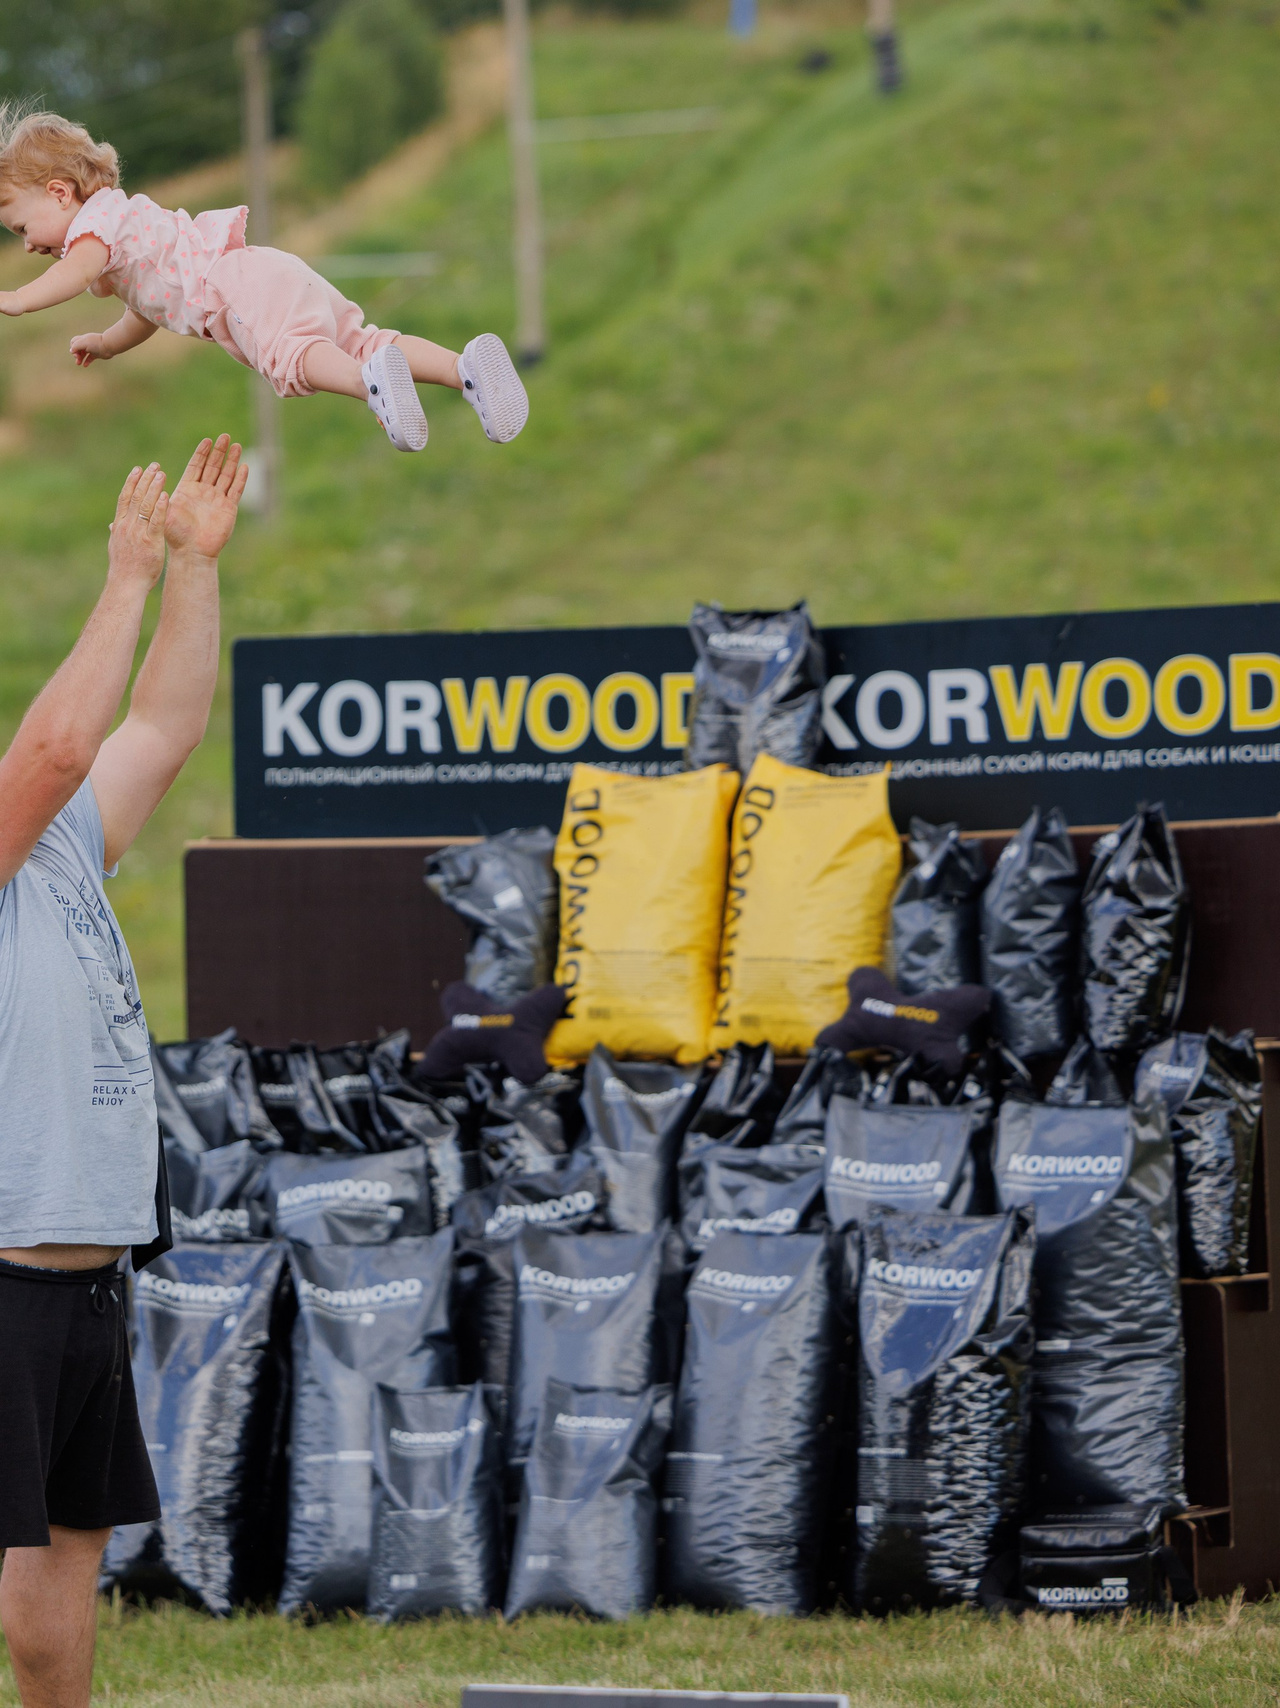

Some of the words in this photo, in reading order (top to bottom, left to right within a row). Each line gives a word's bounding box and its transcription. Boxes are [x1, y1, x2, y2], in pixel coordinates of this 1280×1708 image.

[983, 751, 1045, 775] СУХОЙ
[1046, 751, 1102, 772] КОРМ
[1102, 749, 1143, 772] ДЛЯ
[1144, 747, 1210, 768] СОБАК
[1211, 746, 1227, 765] И
[494, 763, 543, 783] КОРМ
[544, 762, 576, 784] ДЛ
[91, 1096, 124, 1106] ENJOY
[93, 1085, 128, 1095] RELAX
[131, 1086, 137, 1094] &
[829, 1155, 941, 1184] KORWOOD
[1007, 1152, 1123, 1176] KORWOOD
[696, 1266, 794, 1292] KORWOO
[298, 1278, 423, 1307] KORWOOD
[1038, 1586, 1129, 1602] KORWOOD
